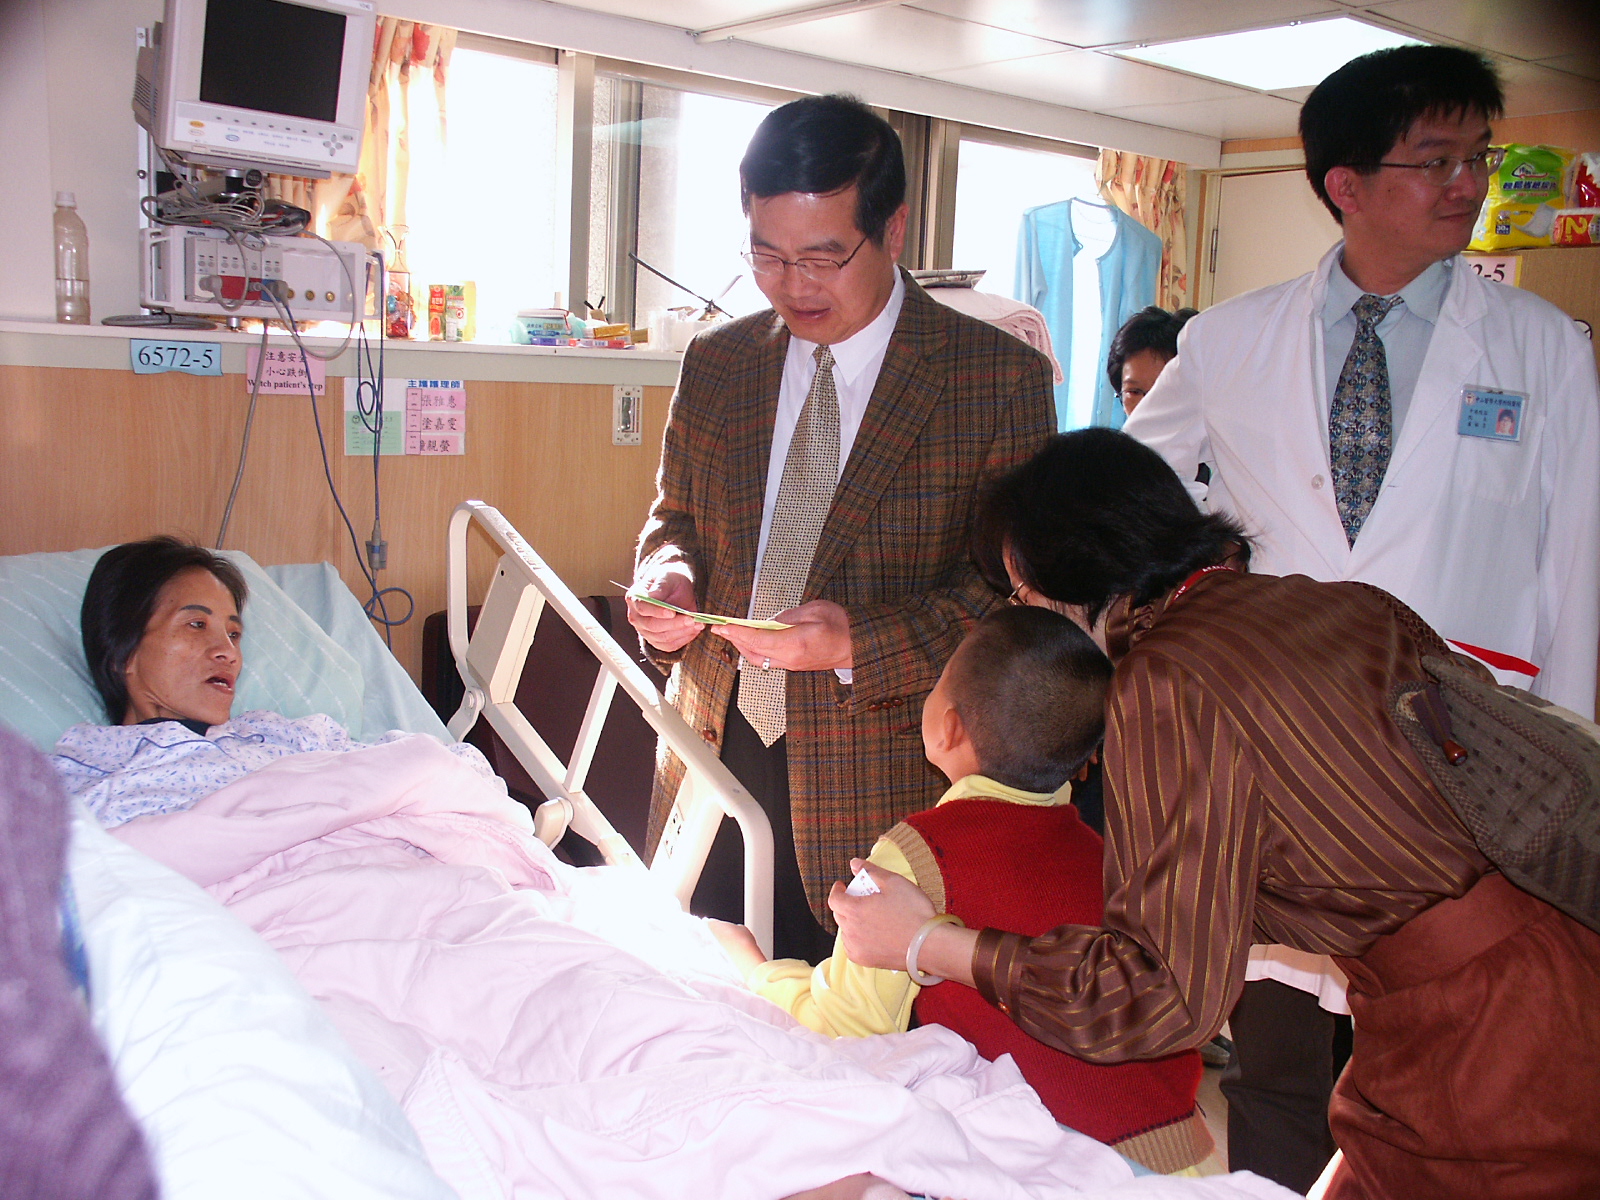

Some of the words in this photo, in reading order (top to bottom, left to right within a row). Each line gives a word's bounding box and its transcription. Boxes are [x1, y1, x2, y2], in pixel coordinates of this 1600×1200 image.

[1468, 263, 1506, 283] 2-5
[138, 345, 213, 368] 6572-5
[247, 379, 272, 388] Wtch
[273, 381, 307, 389] patient's
